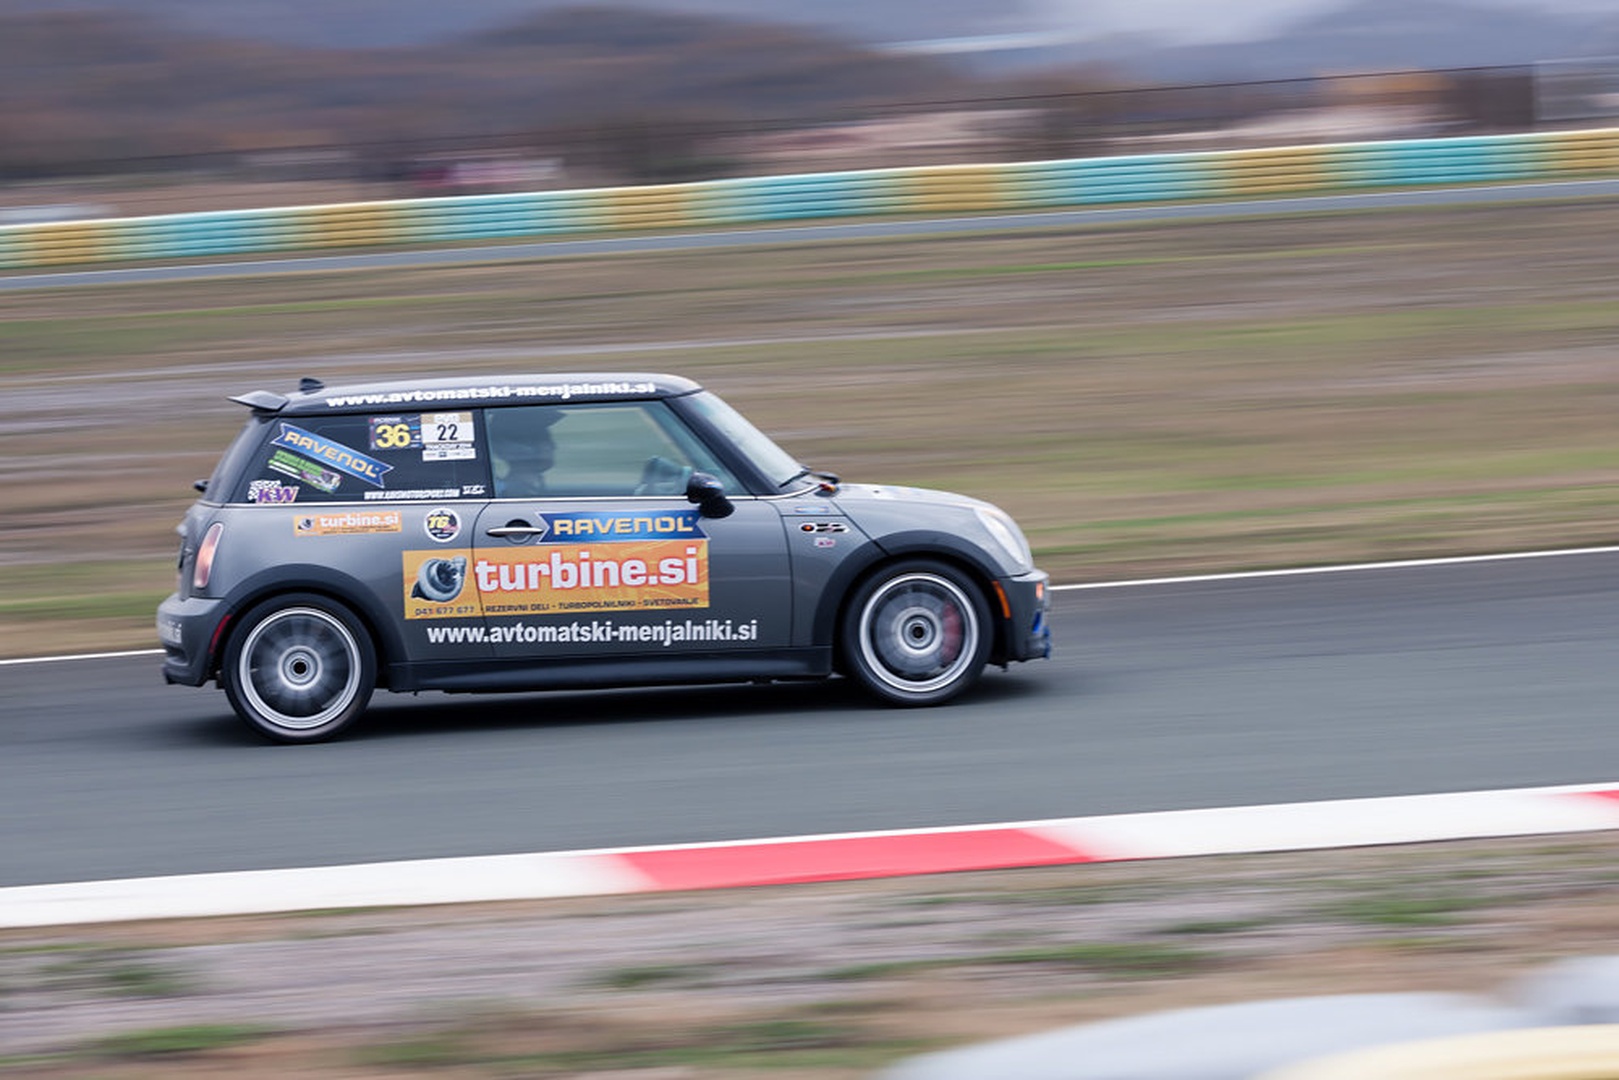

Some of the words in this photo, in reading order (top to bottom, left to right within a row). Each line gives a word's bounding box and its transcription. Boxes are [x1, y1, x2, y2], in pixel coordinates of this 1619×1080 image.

[326, 382, 655, 407] www.avtomatski-menjalniki.si
[375, 424, 411, 448] 36
[437, 424, 458, 441] 22
[284, 431, 380, 478] RAVENOL
[320, 512, 398, 527] turbine.si
[553, 516, 694, 535] RAVENOL
[475, 547, 698, 593] turbine.si
[485, 604, 529, 613] REZERVNI
[530, 603, 550, 611] DELI
[427, 619, 758, 646] www.avtomatski-menjalniki.si
